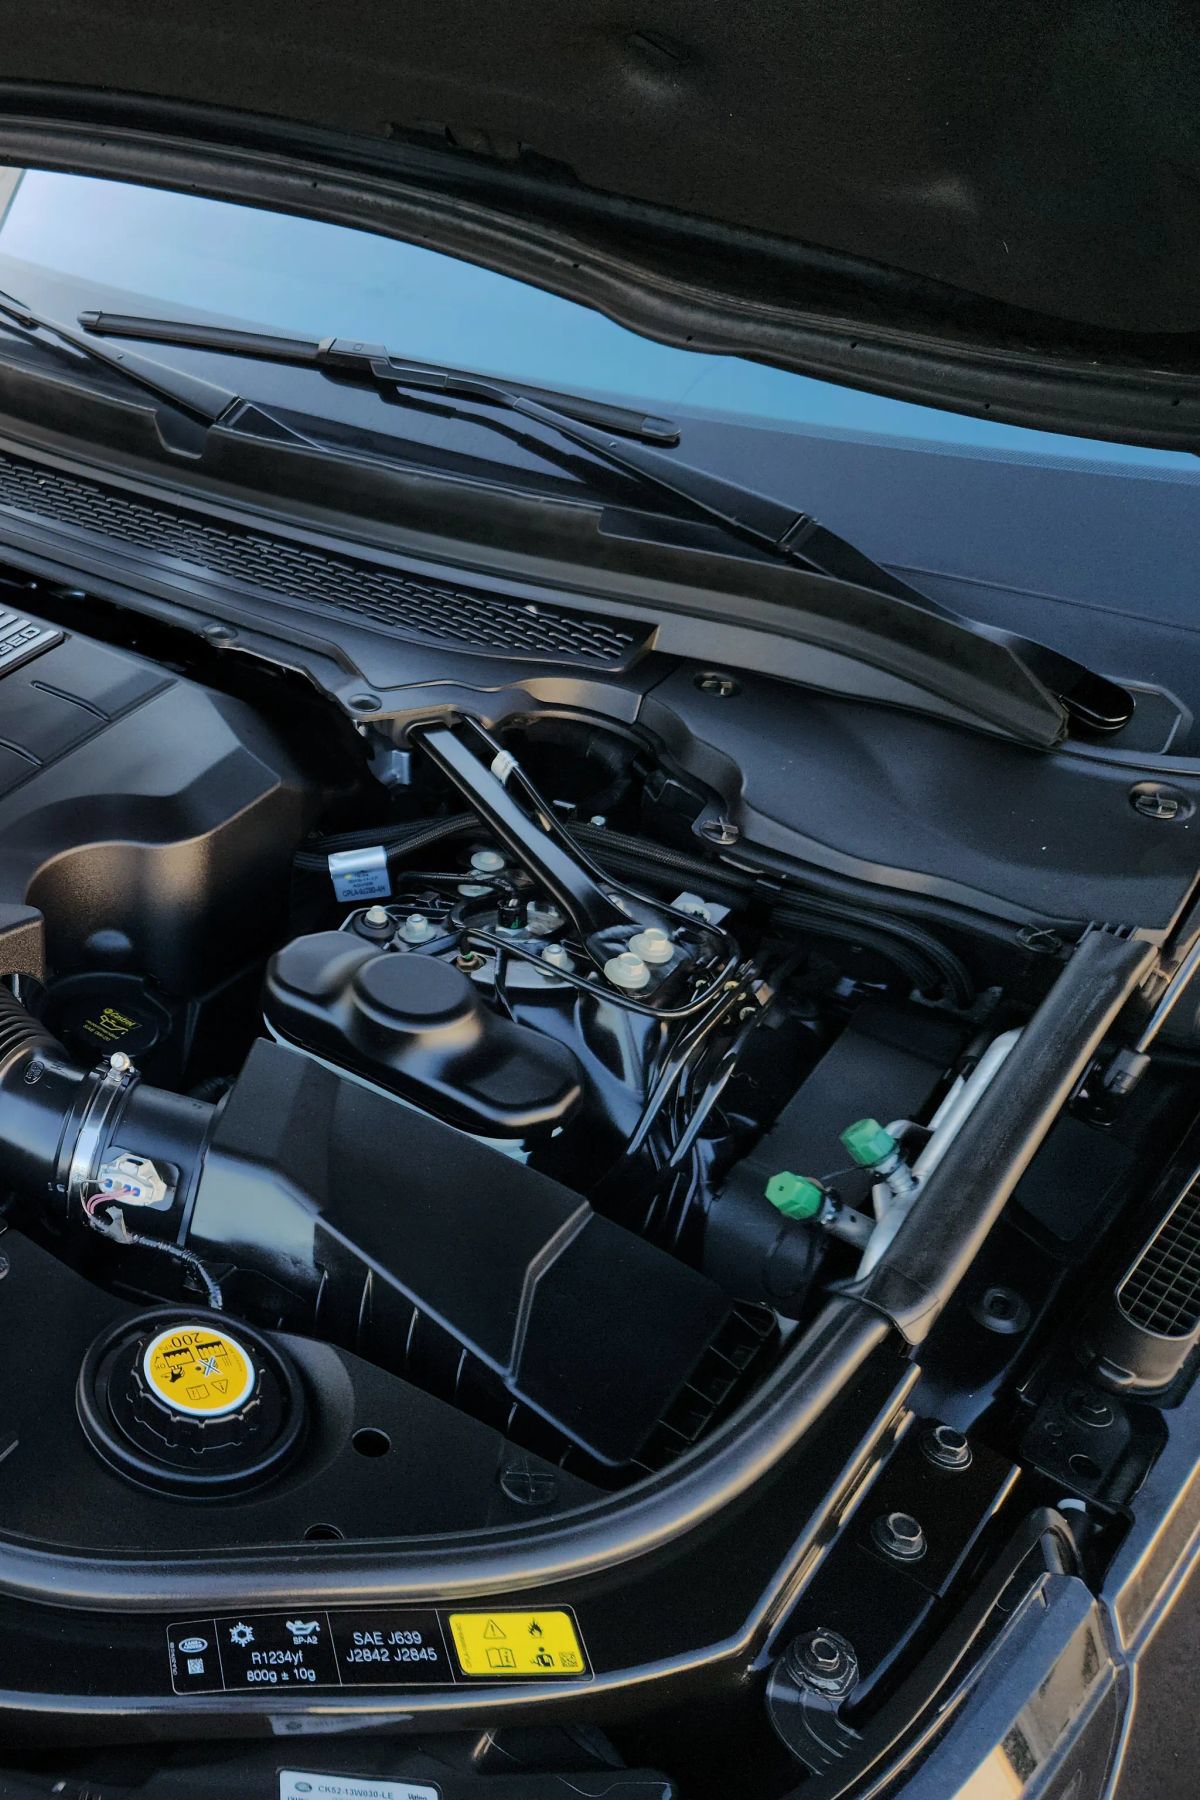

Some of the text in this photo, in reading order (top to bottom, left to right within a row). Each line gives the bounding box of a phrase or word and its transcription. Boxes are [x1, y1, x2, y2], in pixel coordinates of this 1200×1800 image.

[171, 1332, 201, 1349] 200
[353, 1631, 423, 1646] SAE J639
[251, 1650, 304, 1666] R1234yf
[346, 1646, 438, 1663] J2842 J2845
[247, 1669, 278, 1683] 800g
[293, 1667, 317, 1681] 10g
